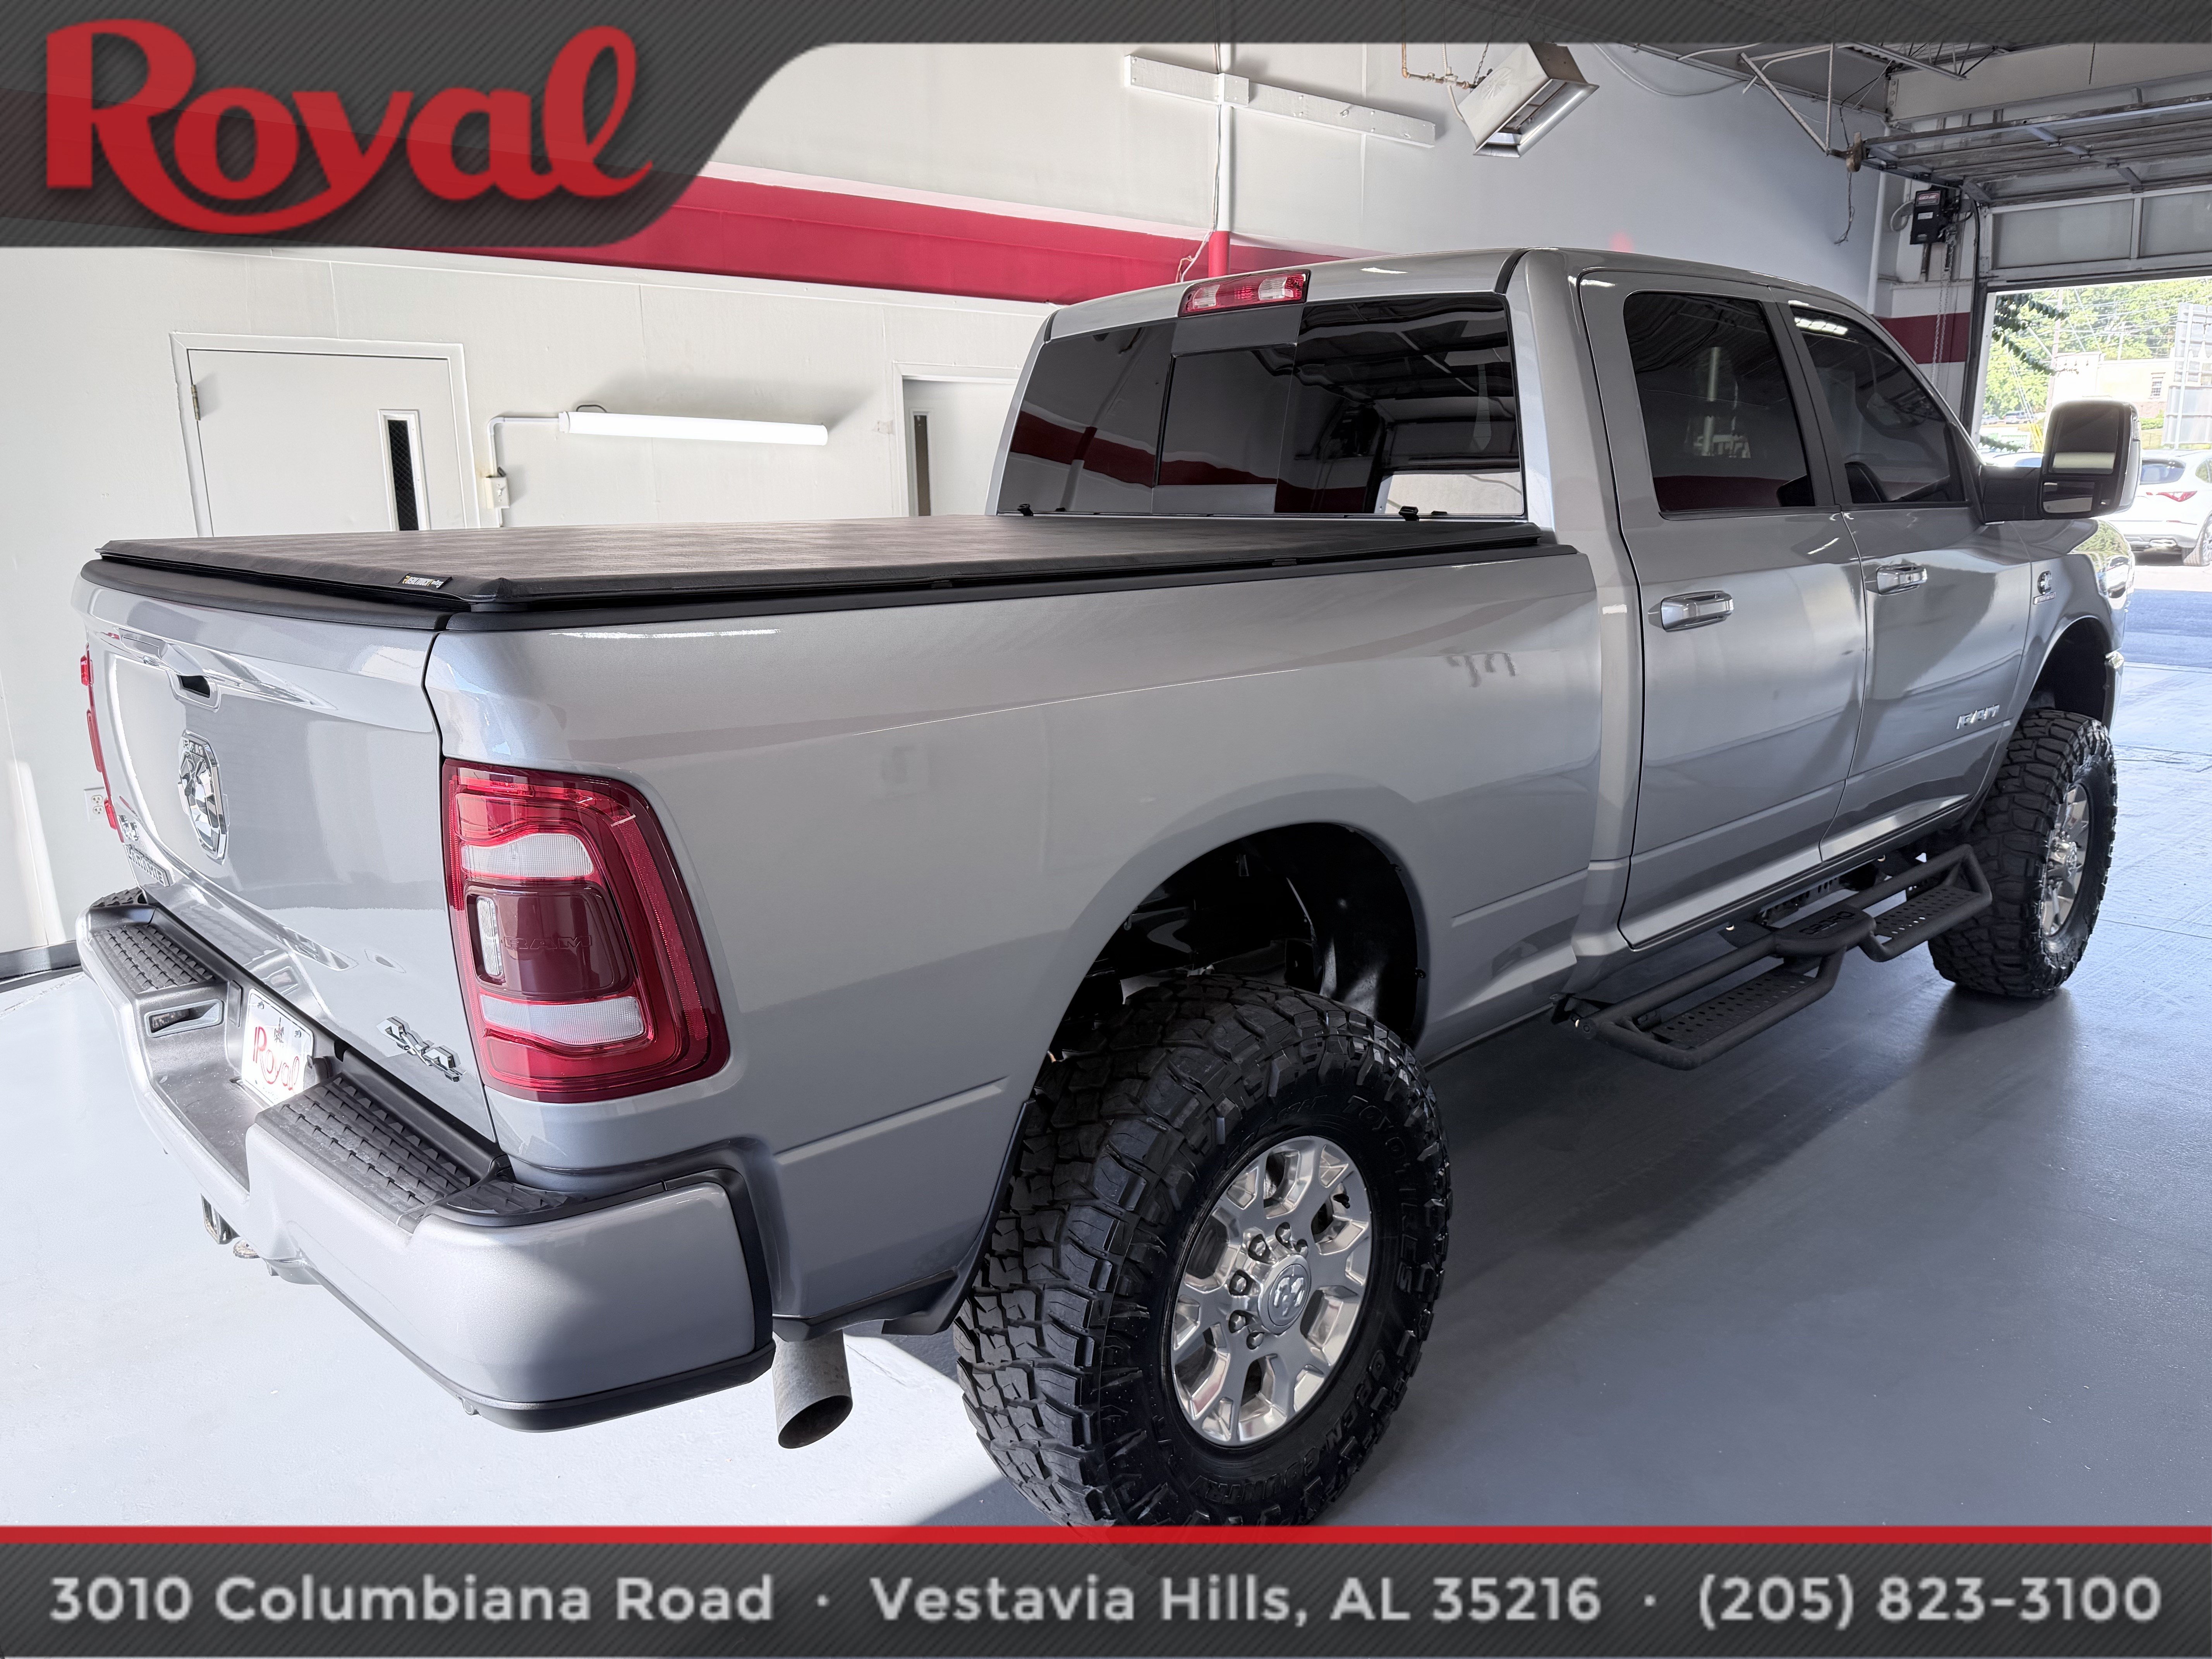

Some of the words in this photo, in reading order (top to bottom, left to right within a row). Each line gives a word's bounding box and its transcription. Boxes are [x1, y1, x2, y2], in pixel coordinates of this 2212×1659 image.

[1956, 704, 2000, 730] RAM
[503, 935, 592, 950] RAM
[253, 1026, 300, 1091] Royal
